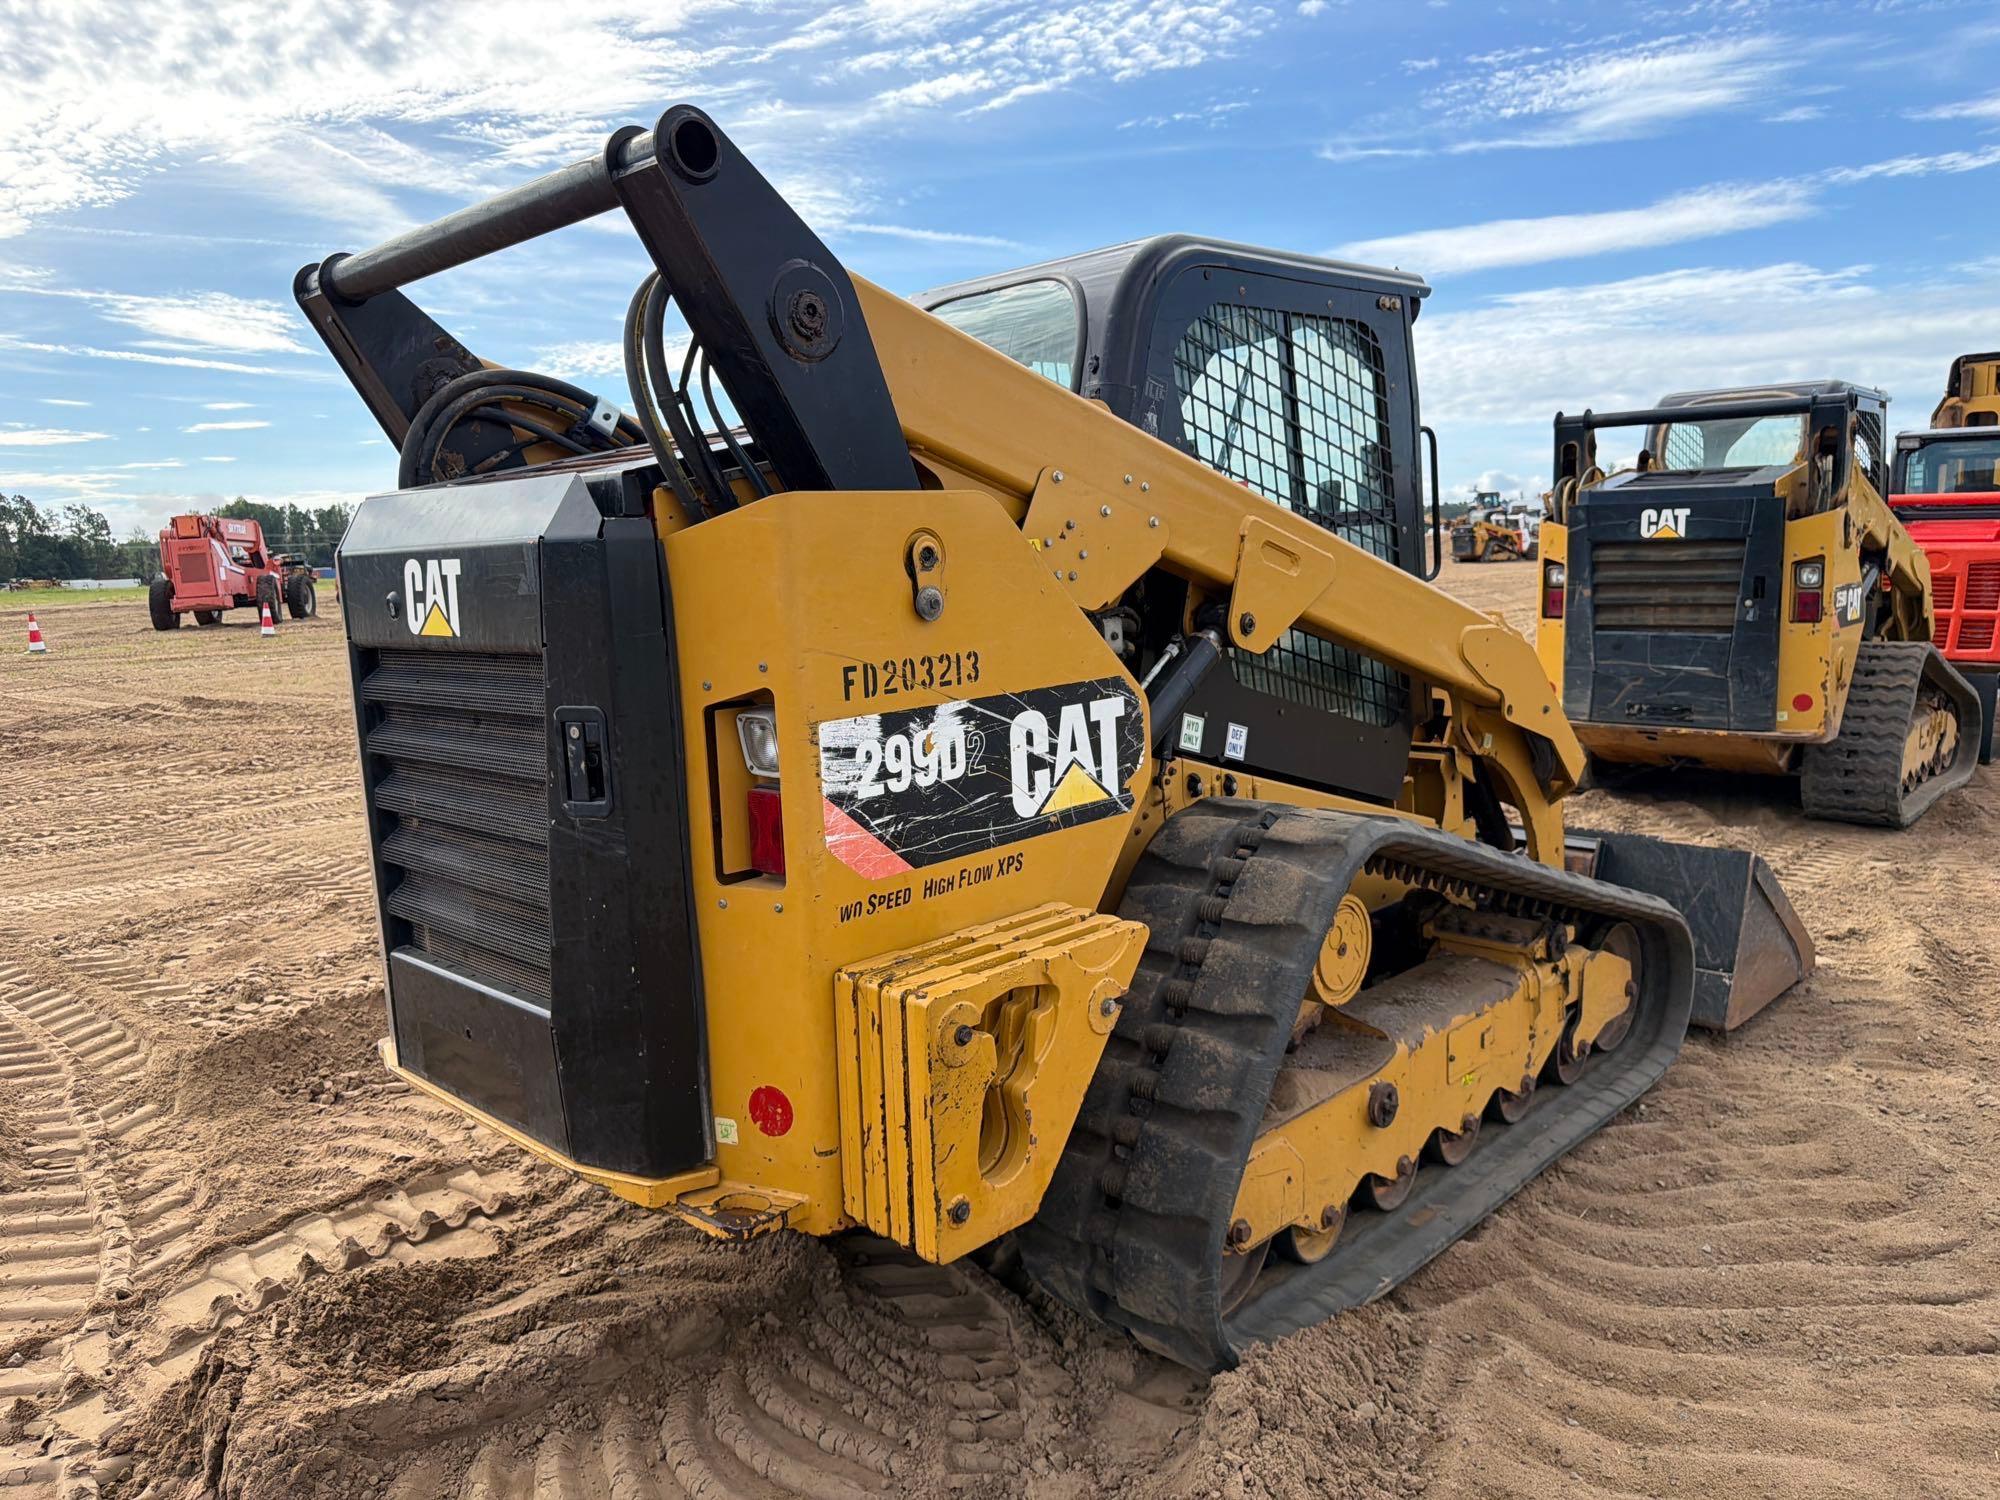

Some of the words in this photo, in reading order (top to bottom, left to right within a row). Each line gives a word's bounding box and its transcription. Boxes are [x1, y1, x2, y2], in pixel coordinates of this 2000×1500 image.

[1640, 508, 1691, 539] CAT
[403, 558, 462, 638] CAT
[1847, 587, 1862, 621] CAT
[842, 650, 980, 702] FD203213
[1183, 733, 1199, 746] ONLY
[1186, 719, 1200, 732] HYD
[1231, 728, 1243, 741] DEF
[1009, 696, 1125, 819] CAT
[1227, 742, 1243, 755] ONLY
[996, 852, 1024, 878] XPS
